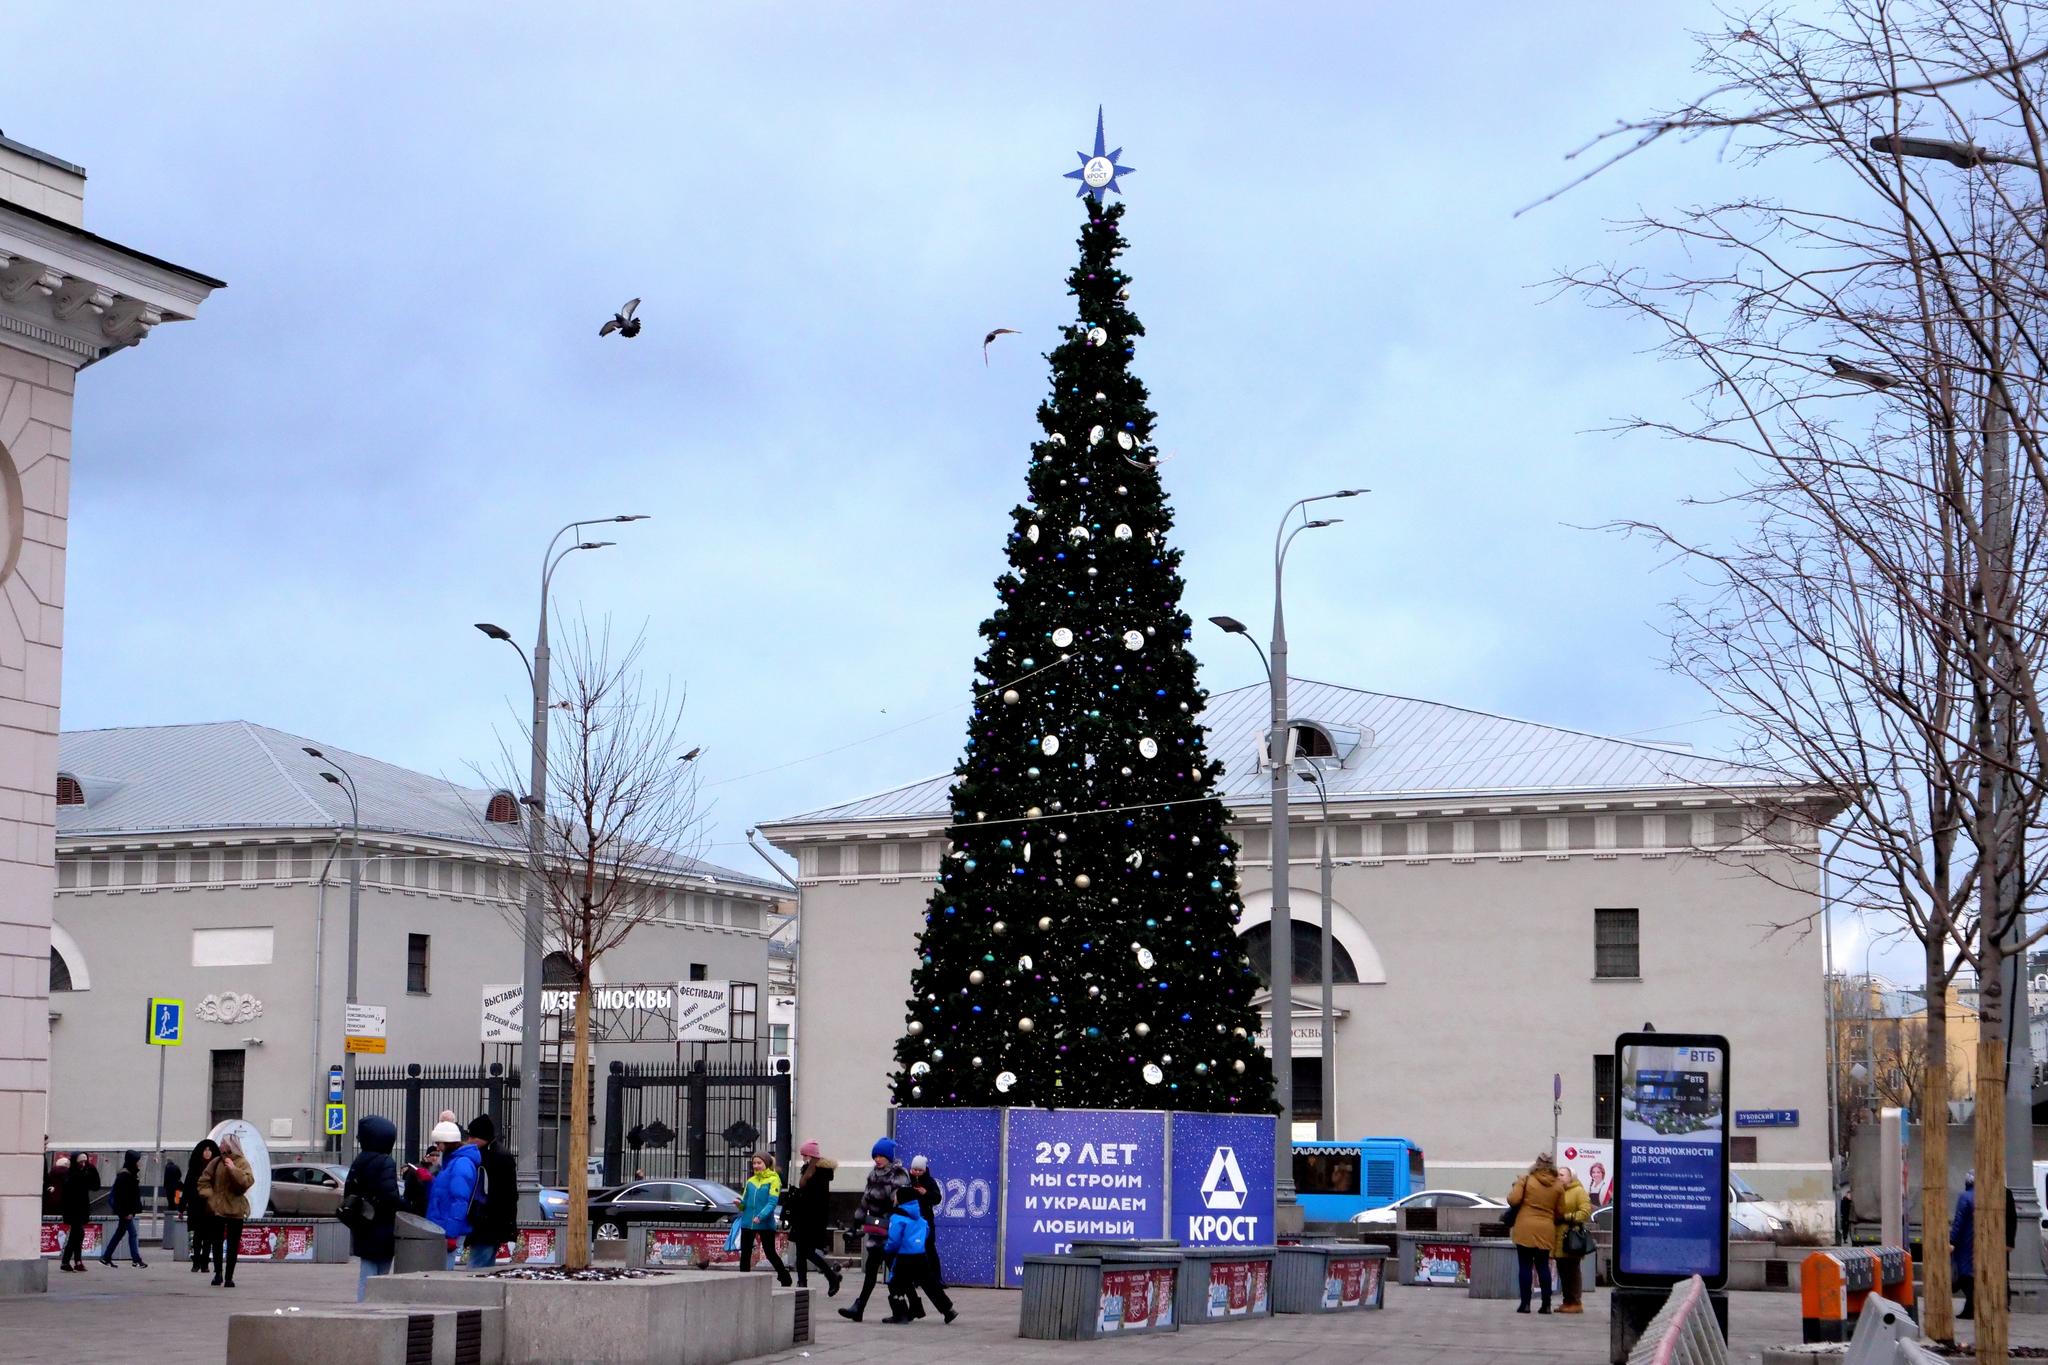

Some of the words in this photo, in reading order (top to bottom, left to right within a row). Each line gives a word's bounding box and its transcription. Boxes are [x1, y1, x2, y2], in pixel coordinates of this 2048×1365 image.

[484, 986, 523, 1007] ВЫСТАВКИ
[541, 990, 580, 1010] УЗЕ
[597, 989, 671, 1009] МОСКВЫ
[680, 986, 724, 1000] ФЕСТИВАЛИ
[683, 1002, 699, 1018] КИНО
[484, 1012, 510, 1027] ДЕТСКИЙ
[486, 1029, 501, 1037] КАФЕ
[698, 1023, 727, 1036] СУВЕНИРЫ
[1690, 1051, 1716, 1062] ВТБ
[1785, 1112, 1791, 1120] 2
[1036, 1142, 1071, 1164] 29
[1078, 1143, 1138, 1165] ЛЕТ
[1631, 1146, 1647, 1154] ВСЕ
[1648, 1146, 1714, 1156] ВОЗМОЖНОСТИ
[1631, 1156, 1647, 1164] ДЛЯ
[1648, 1156, 1671, 1165] РОСТА
[1030, 1173, 1061, 1187] МЫ
[1066, 1174, 1142, 1188] СТРОИМ
[932, 1178, 991, 1218] 20
[1025, 1196, 1037, 1209] И
[1042, 1196, 1146, 1211] УКРАШАЕМ
[1033, 1219, 1135, 1234] ЛЮБИМЫЙ
[1189, 1215, 1258, 1241] КРОСТ
